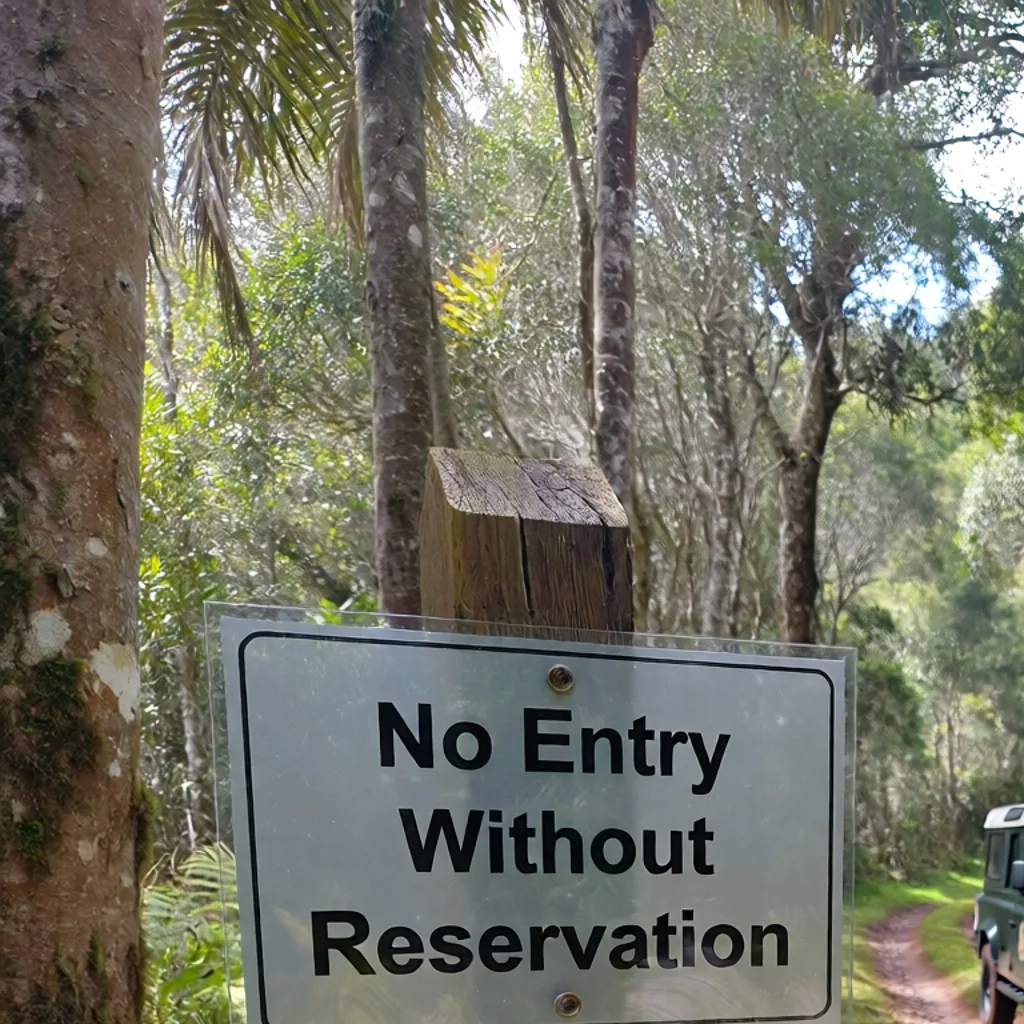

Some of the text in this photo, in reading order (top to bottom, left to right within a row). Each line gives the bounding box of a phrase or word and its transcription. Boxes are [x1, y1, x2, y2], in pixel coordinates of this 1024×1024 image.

[378, 702, 731, 795] No Entry
[399, 808, 715, 875] Without
[311, 909, 789, 977] Reservation
